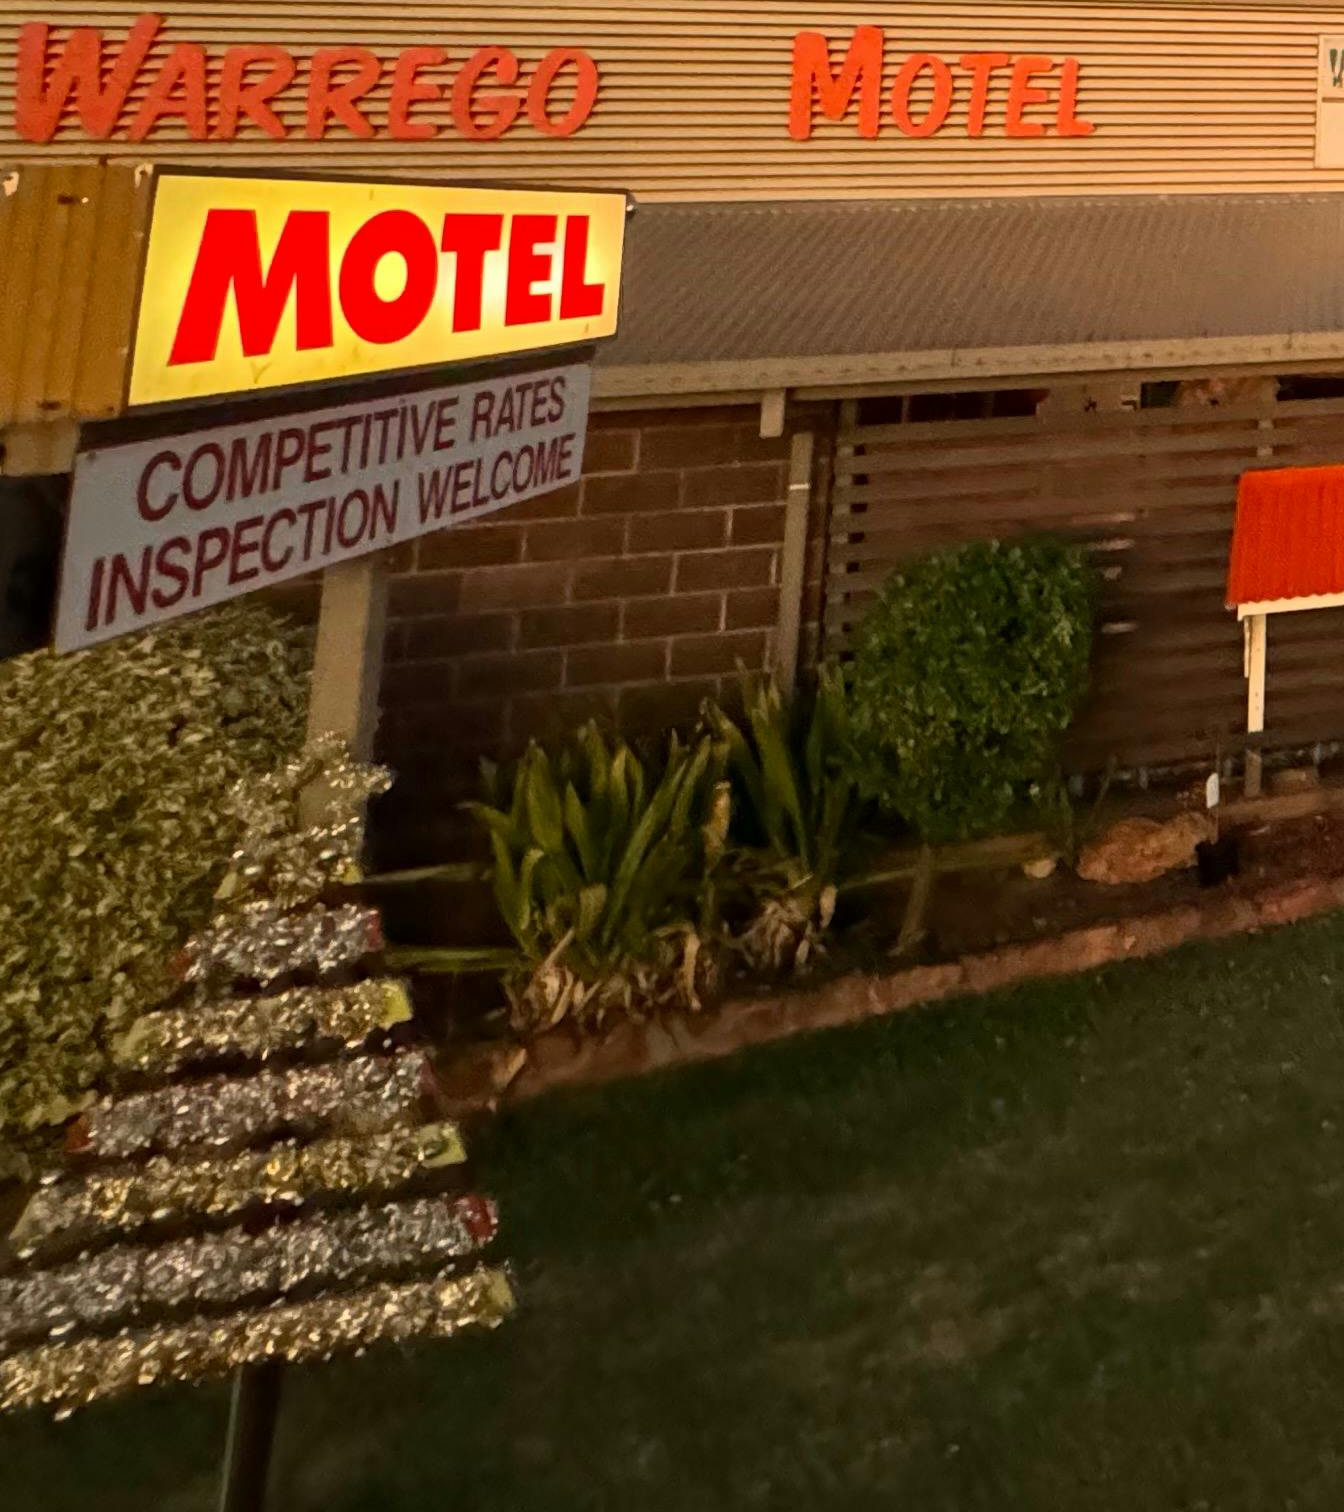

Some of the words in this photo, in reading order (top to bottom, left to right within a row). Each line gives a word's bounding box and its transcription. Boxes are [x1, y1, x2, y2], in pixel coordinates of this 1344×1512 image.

[13, 13, 599, 143] WARREGO
[788, 25, 1095, 140] MOTEL
[167, 208, 606, 366] MOTEL
[136, 396, 459, 522] COMPETITIVE
[470, 376, 567, 440] RATES
[85, 479, 400, 631] INSPECTION
[418, 433, 576, 524] WELCOME
